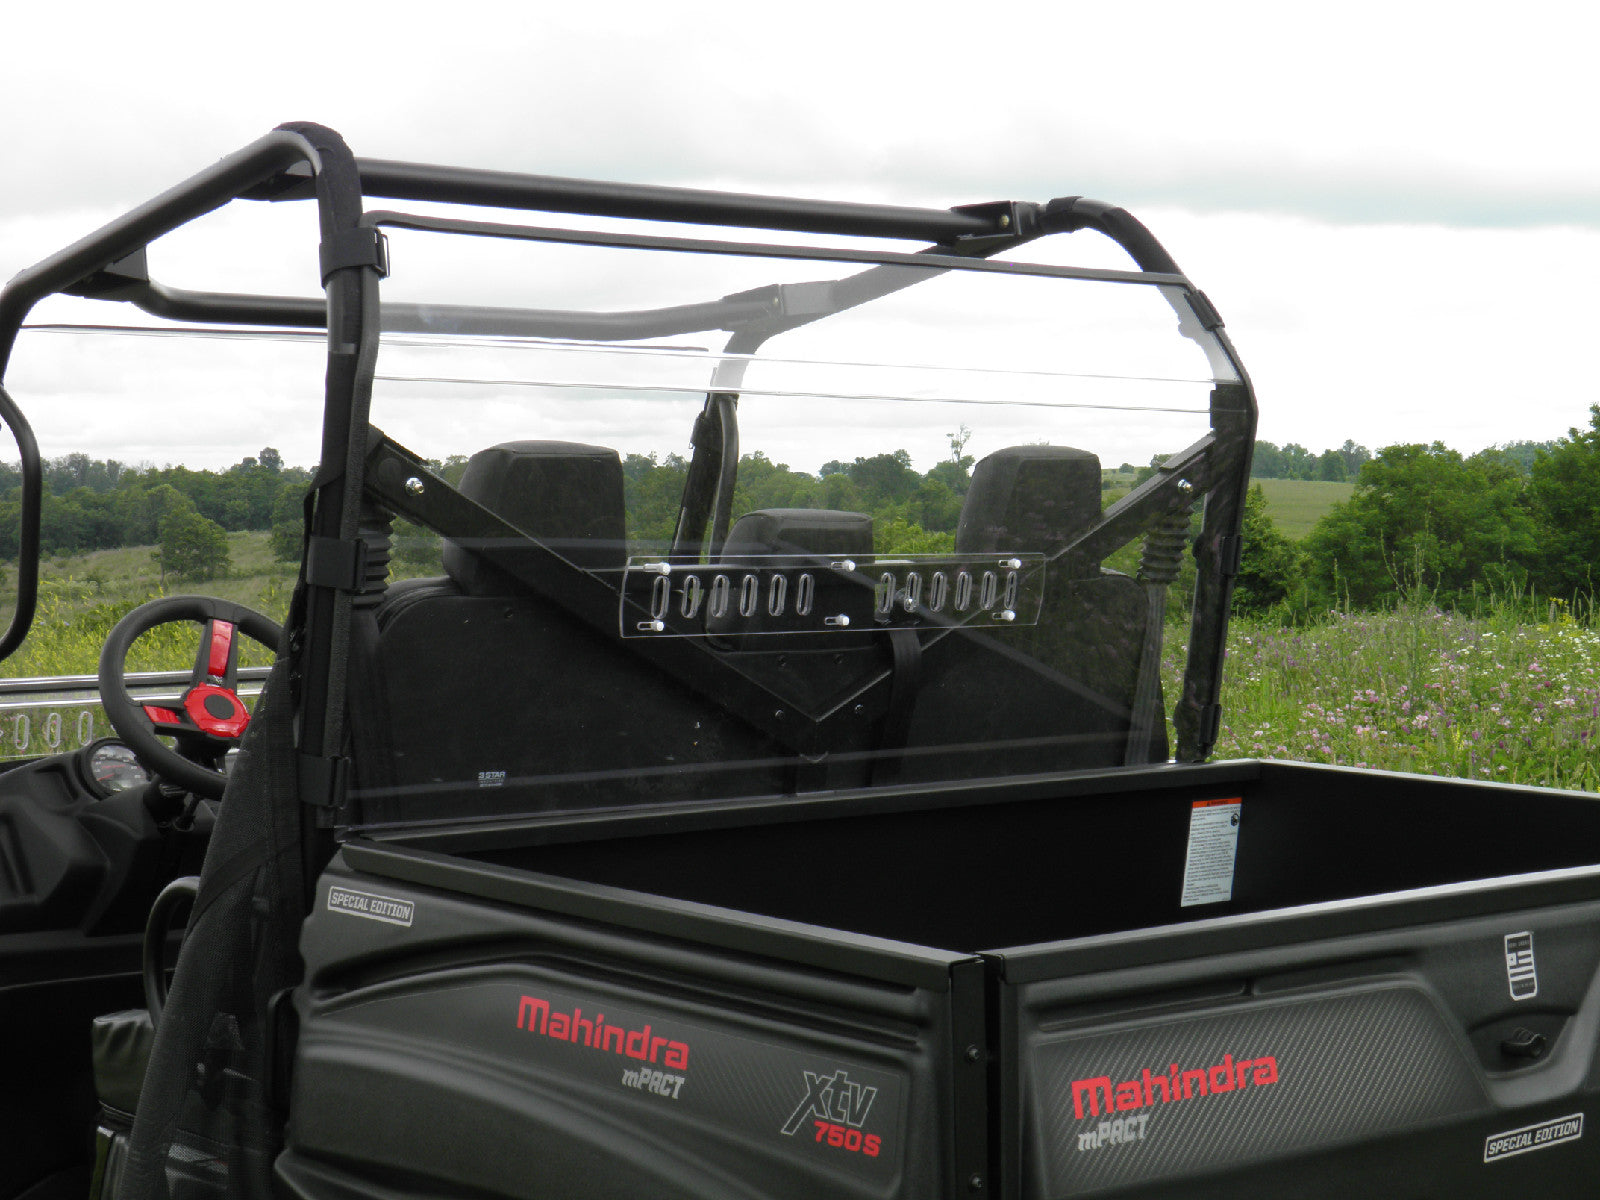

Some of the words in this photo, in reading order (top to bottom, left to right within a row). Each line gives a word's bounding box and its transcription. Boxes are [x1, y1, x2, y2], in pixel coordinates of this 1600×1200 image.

[331, 892, 369, 911] SPECIAL
[370, 900, 411, 920] EDITION
[516, 995, 690, 1071] Mahindra
[621, 1067, 686, 1100] mPACT
[1071, 1053, 1279, 1120] Mahindra
[1077, 1113, 1150, 1152] mPACT
[1488, 1131, 1532, 1155] SPECIAL
[1534, 1119, 1579, 1144] EDITION
